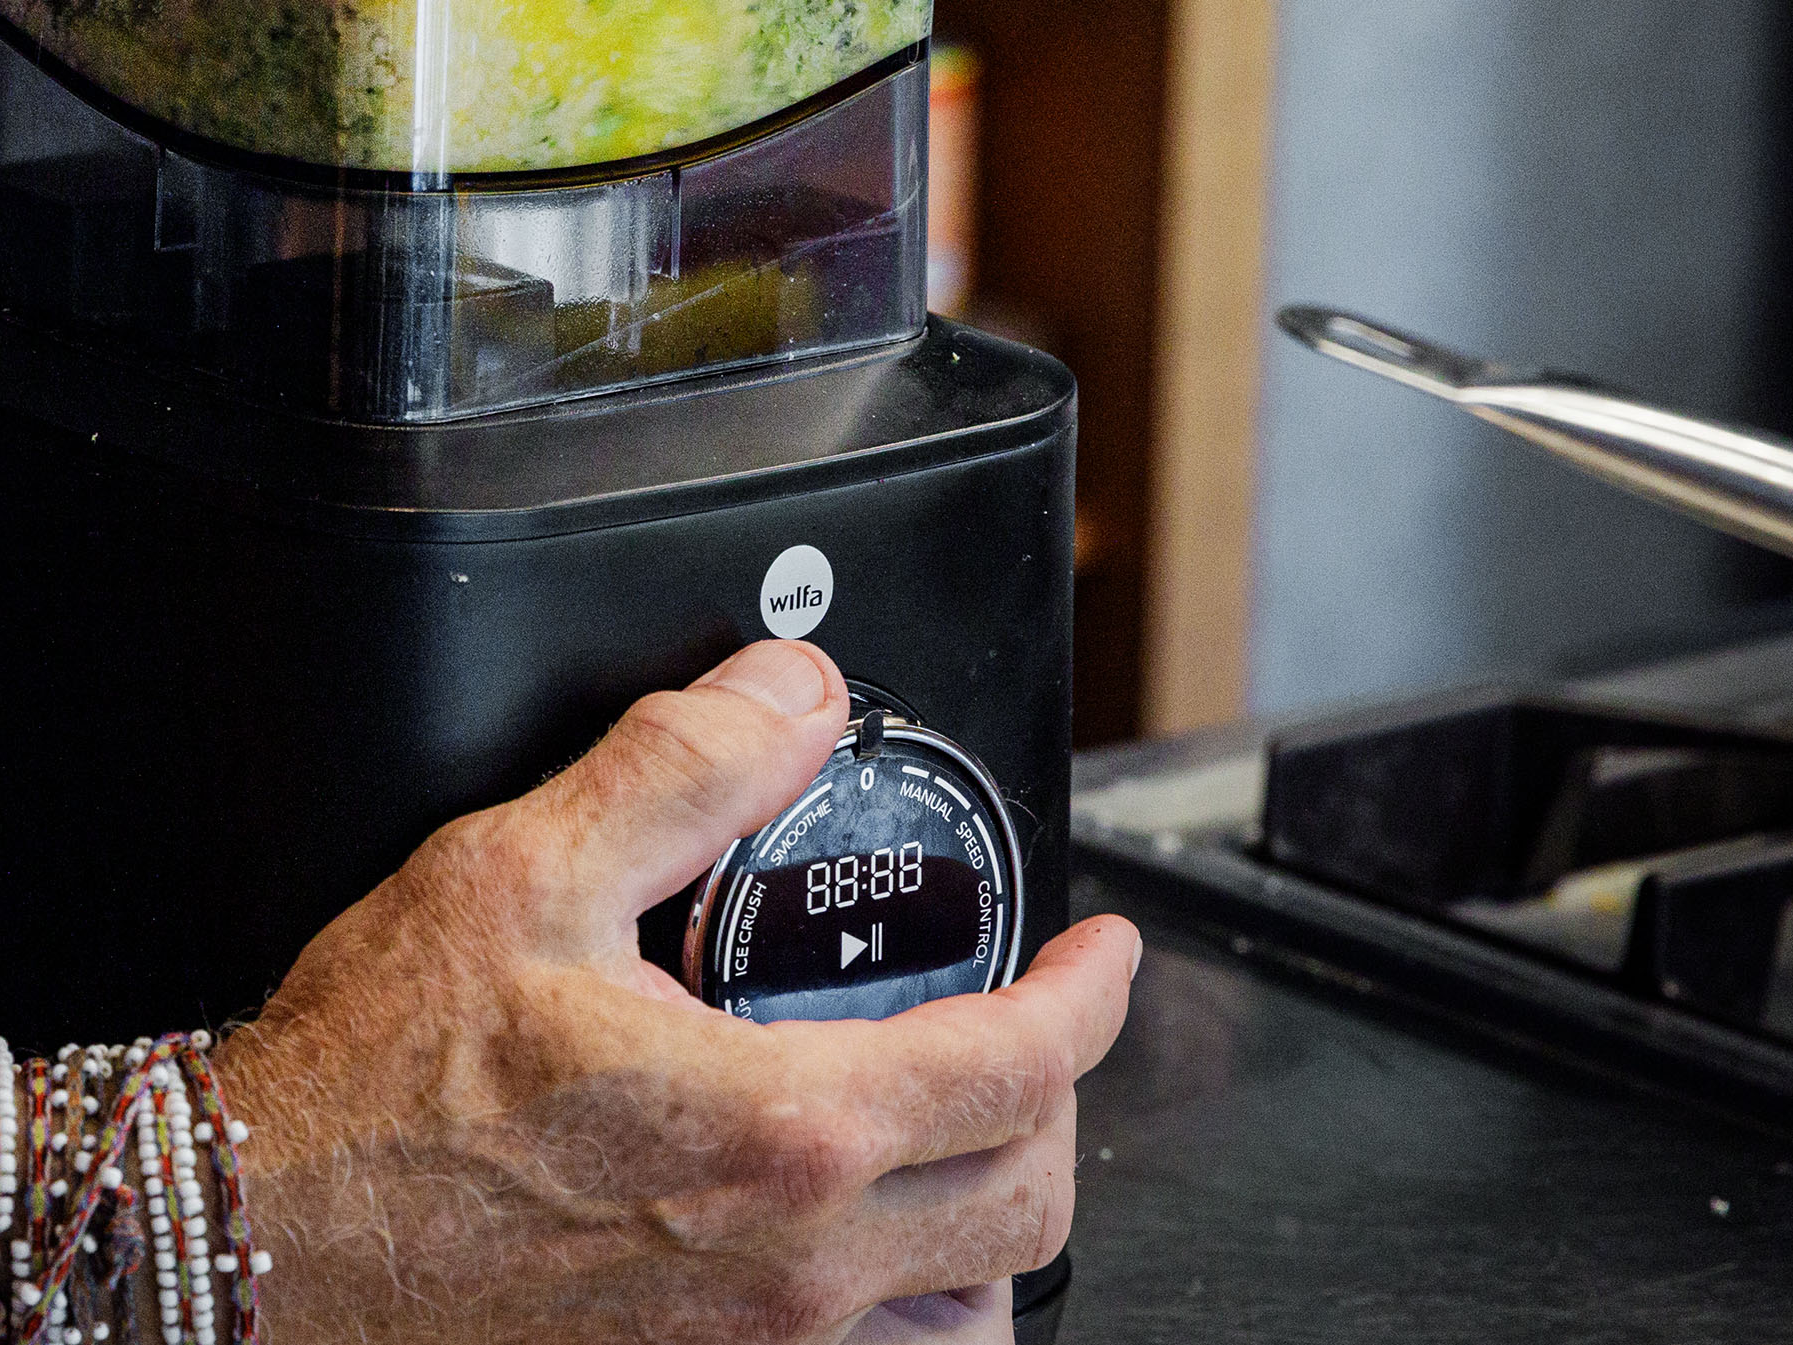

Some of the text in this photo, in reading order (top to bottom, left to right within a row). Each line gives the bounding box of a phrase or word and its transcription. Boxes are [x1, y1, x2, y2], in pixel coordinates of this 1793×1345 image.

[769, 584, 823, 614] wilfa
[859, 766, 875, 792] 0
[770, 798, 833, 867] SMOOTHIE
[807, 840, 923, 916] 88:88
[899, 781, 992, 969] MANUAL SPEED CONTROL
[734, 881, 767, 977] ICE CRUSH
[738, 997, 755, 1023] UP
